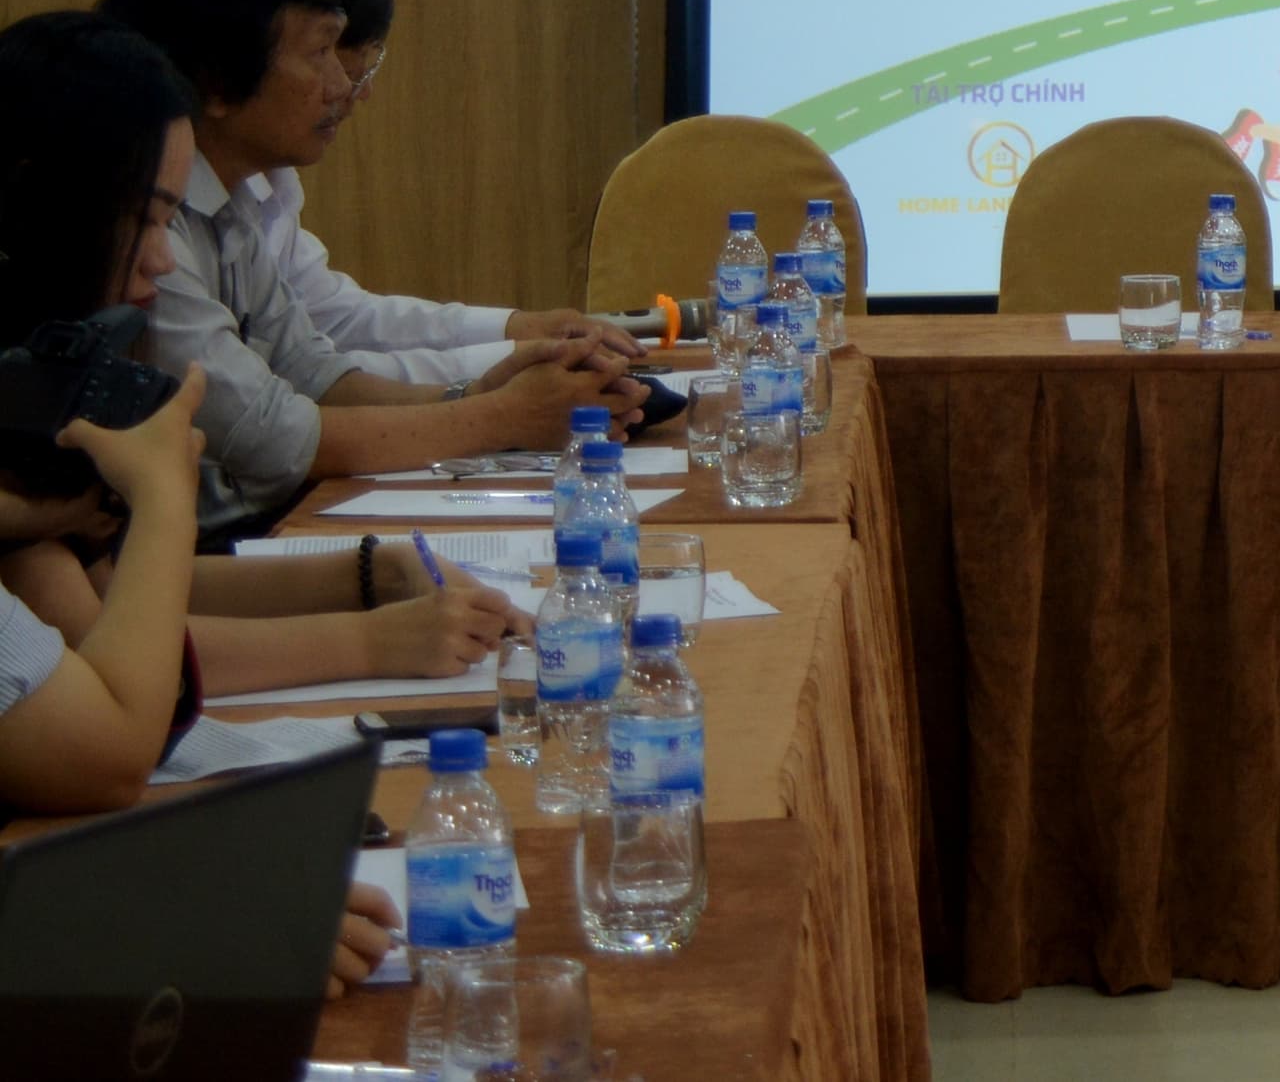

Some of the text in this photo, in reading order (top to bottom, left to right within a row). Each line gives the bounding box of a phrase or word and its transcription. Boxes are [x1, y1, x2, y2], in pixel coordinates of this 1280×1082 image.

[959, 81, 1005, 107] TRỢ
[1011, 78, 1085, 104] CHÍNH
[899, 197, 960, 214] HOME
